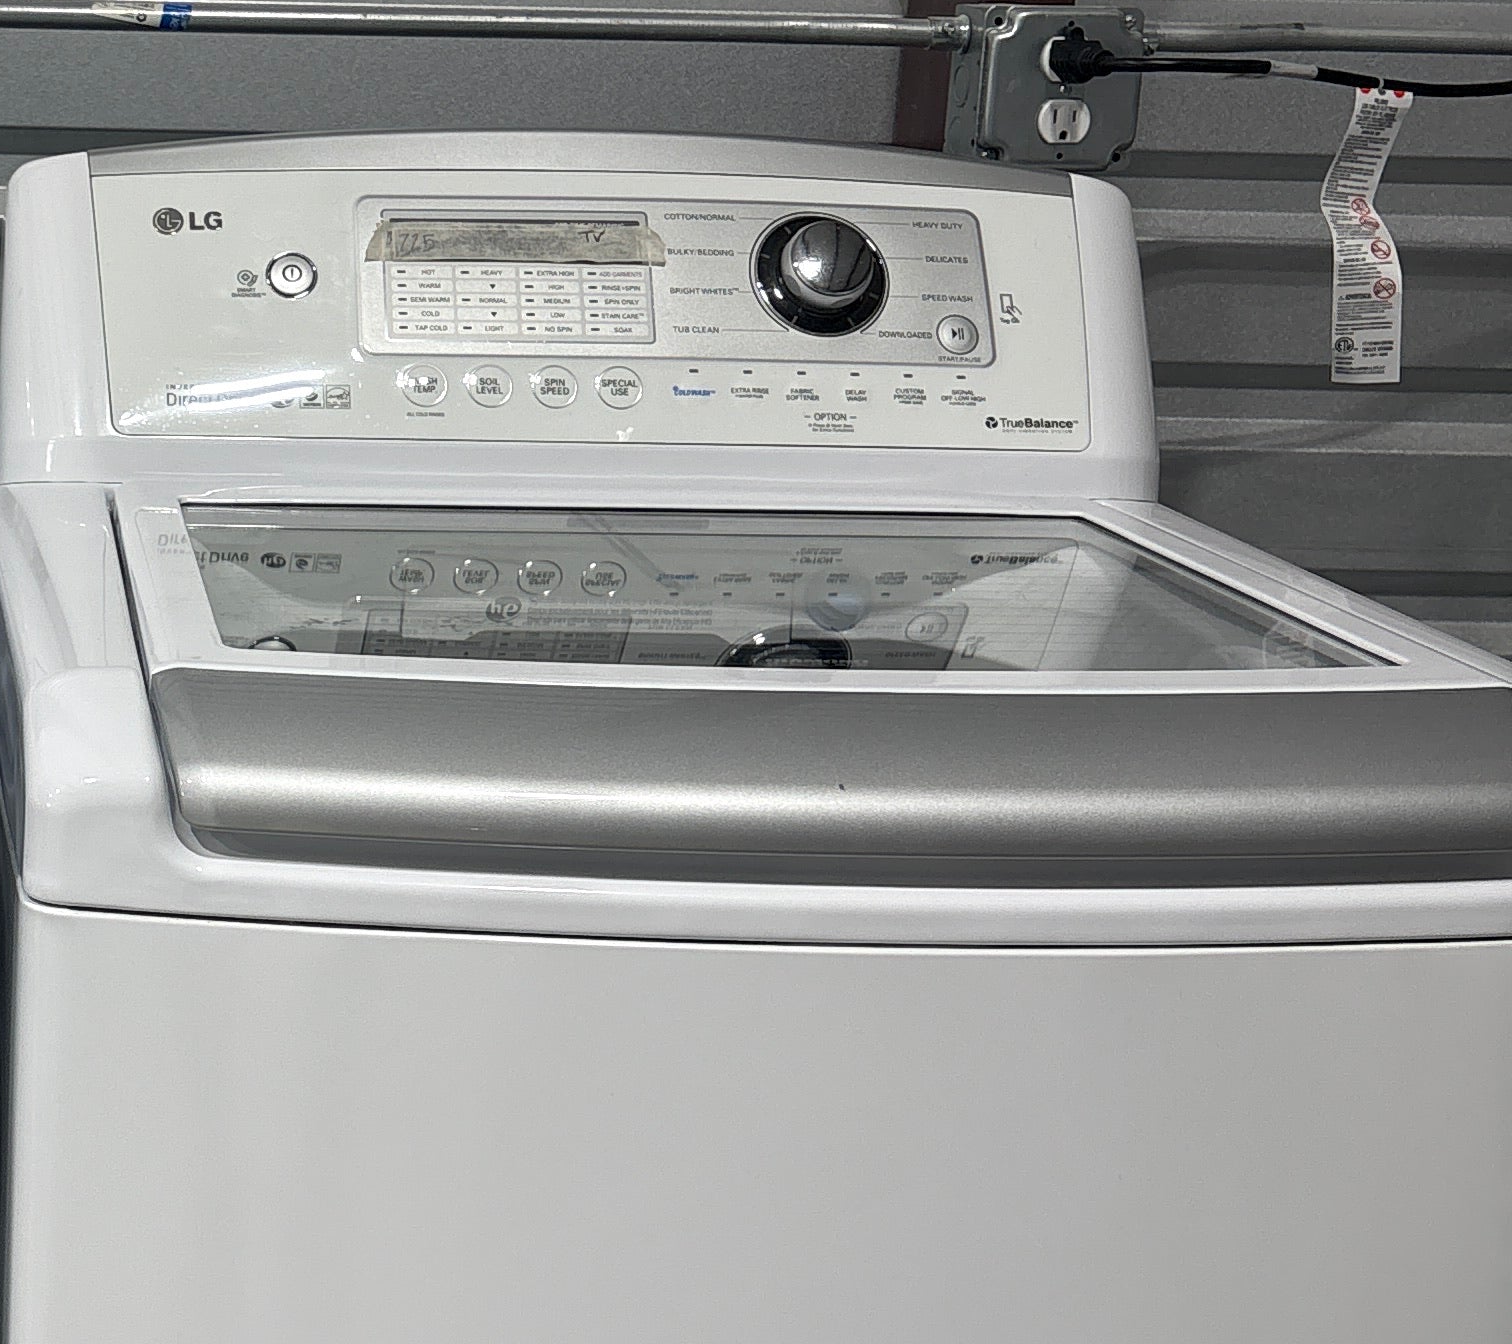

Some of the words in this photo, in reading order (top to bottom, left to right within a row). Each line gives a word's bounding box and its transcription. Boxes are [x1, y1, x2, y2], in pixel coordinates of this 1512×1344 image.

[189, 211, 223, 231] LG
[912, 221, 939, 229] HEAVY
[940, 222, 963, 230] DUTY
[925, 256, 969, 264] DELICATES
[669, 287, 700, 295] BRIGHT
[921, 294, 948, 302] SPEED
[949, 295, 974, 303] WASH
[692, 326, 720, 334] CLEAN
[878, 331, 933, 339] DOWNLOADED
[479, 377, 500, 386] SOIL
[544, 378, 566, 387] SPIN
[601, 379, 638, 388] SPECIAL
[476, 385, 504, 395] LEVEL
[540, 386, 570, 396] SPEED
[610, 387, 629, 396] USE
[814, 413, 847, 421] OPTION
